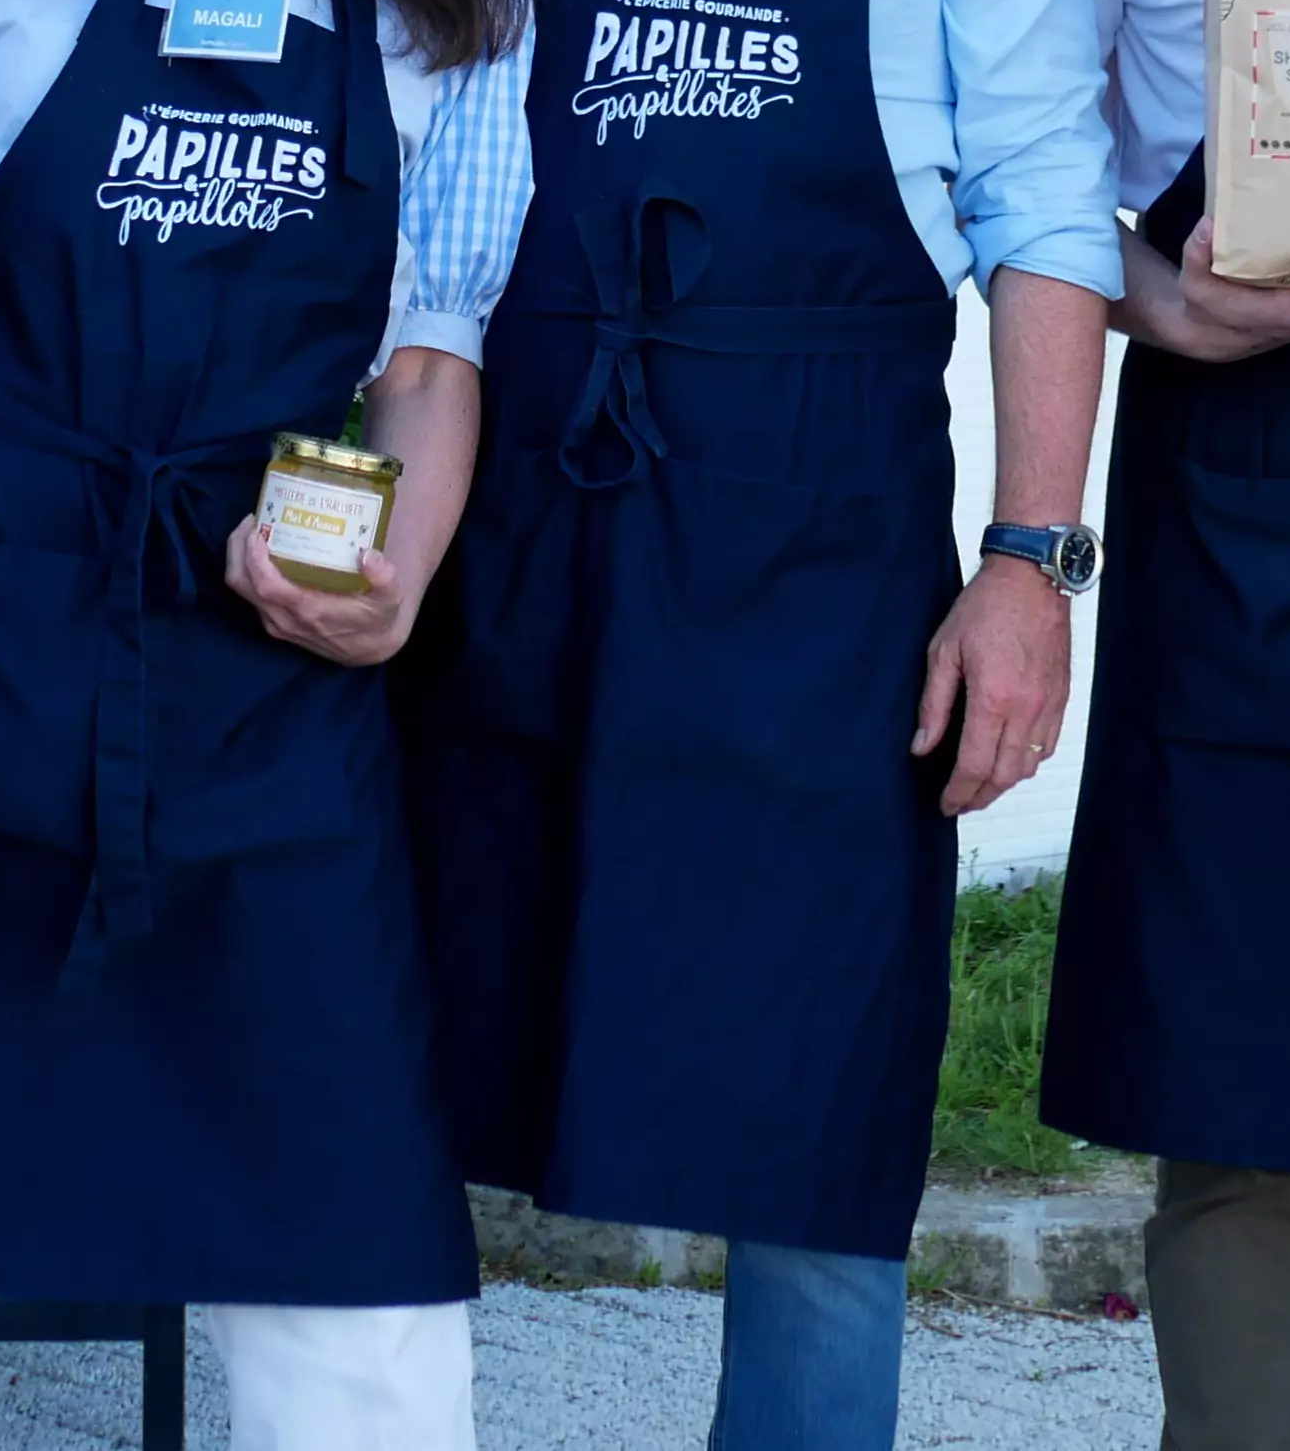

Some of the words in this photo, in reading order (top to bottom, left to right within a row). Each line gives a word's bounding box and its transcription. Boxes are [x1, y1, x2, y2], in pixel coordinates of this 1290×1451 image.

[193, 9, 262, 29] MAGALI
[695, 0, 782, 23] GOURMANDE
[584, 12, 799, 82] PAPILLES
[150, 103, 224, 124] L'ÉPICERIE
[228, 112, 312, 134] GOURMANDE
[594, 69, 793, 146] papillotes
[108, 114, 327, 188] PAPILLES
[118, 178, 313, 245] papillotes
